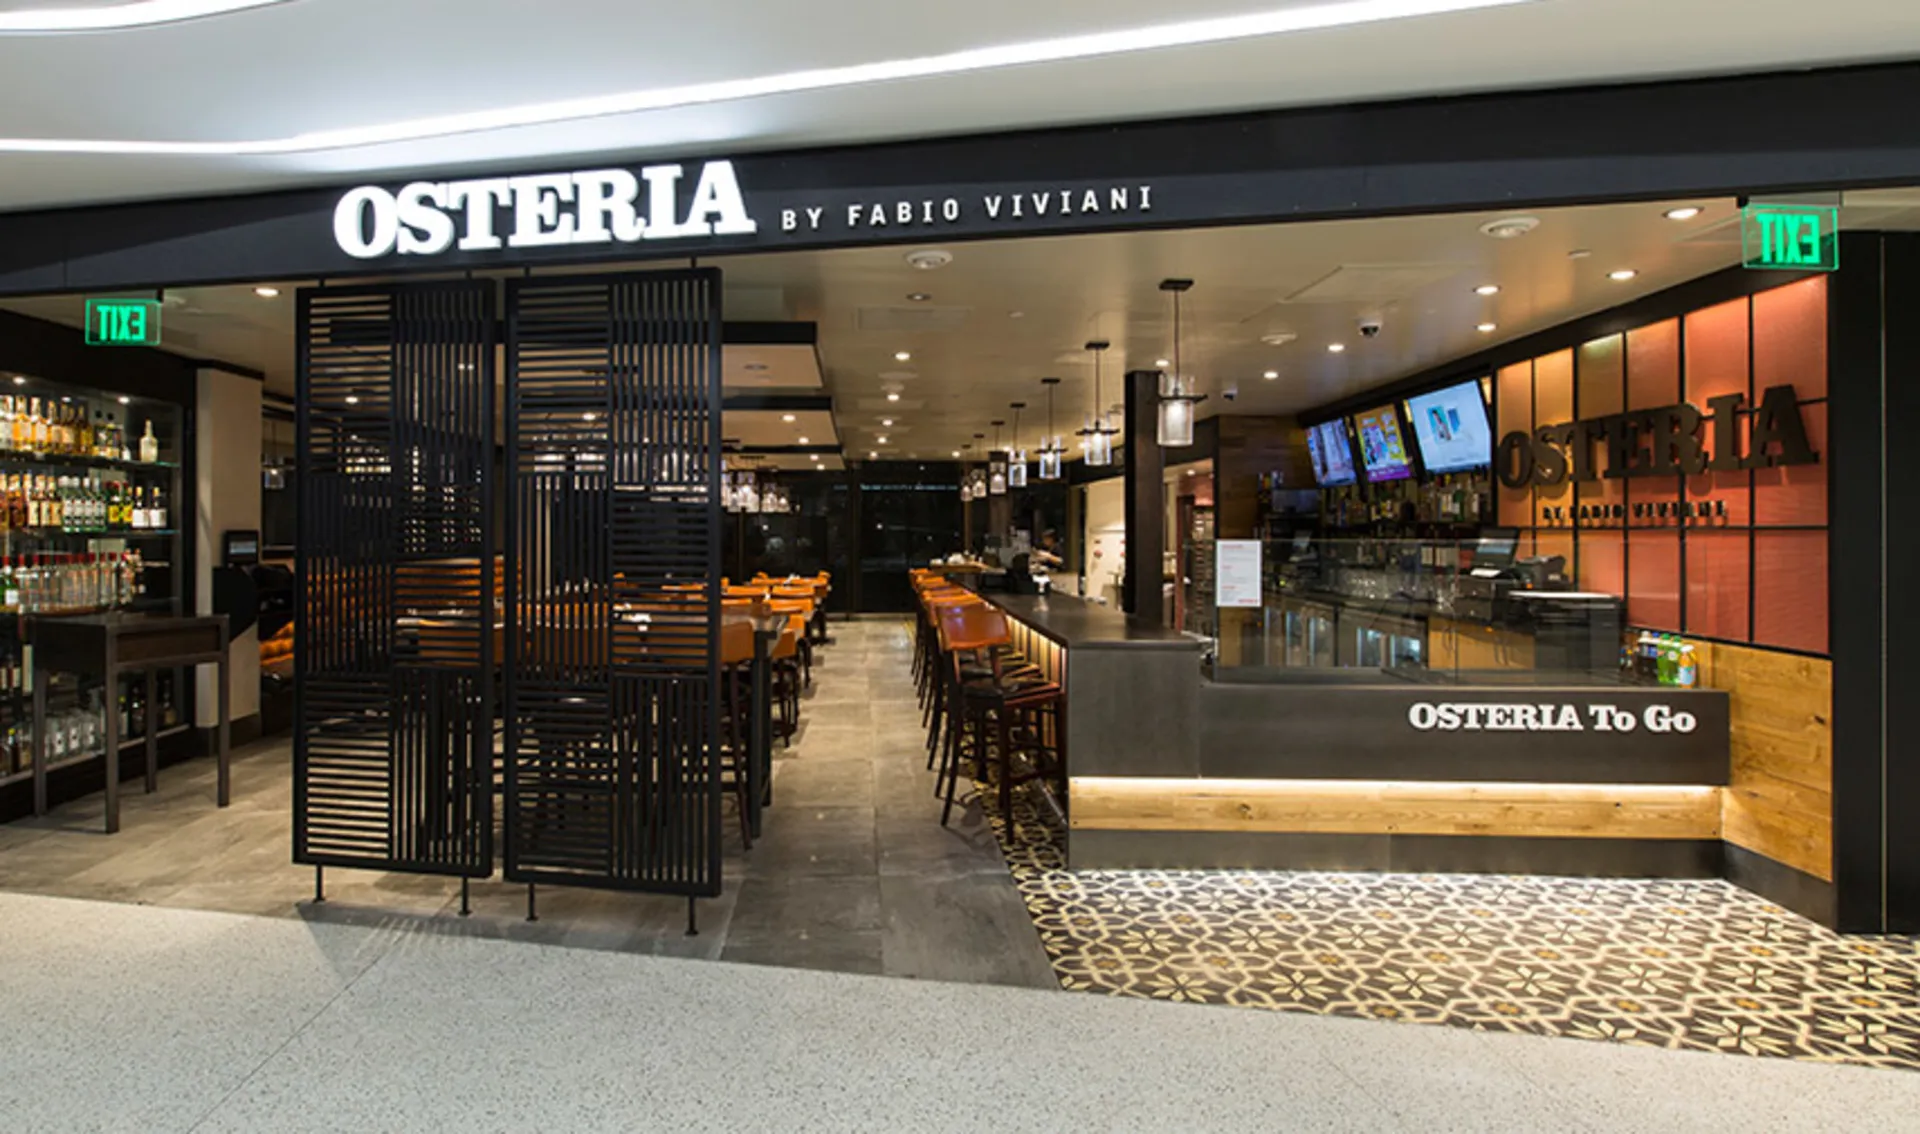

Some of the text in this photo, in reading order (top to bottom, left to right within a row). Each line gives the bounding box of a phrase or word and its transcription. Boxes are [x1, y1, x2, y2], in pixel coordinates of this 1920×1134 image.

[333, 159, 1151, 258] OSTERIA BY FABIO VIVIANI
[1498, 384, 1819, 489] OSTERIA
[1408, 702, 1697, 732] OSTERIA To Go
